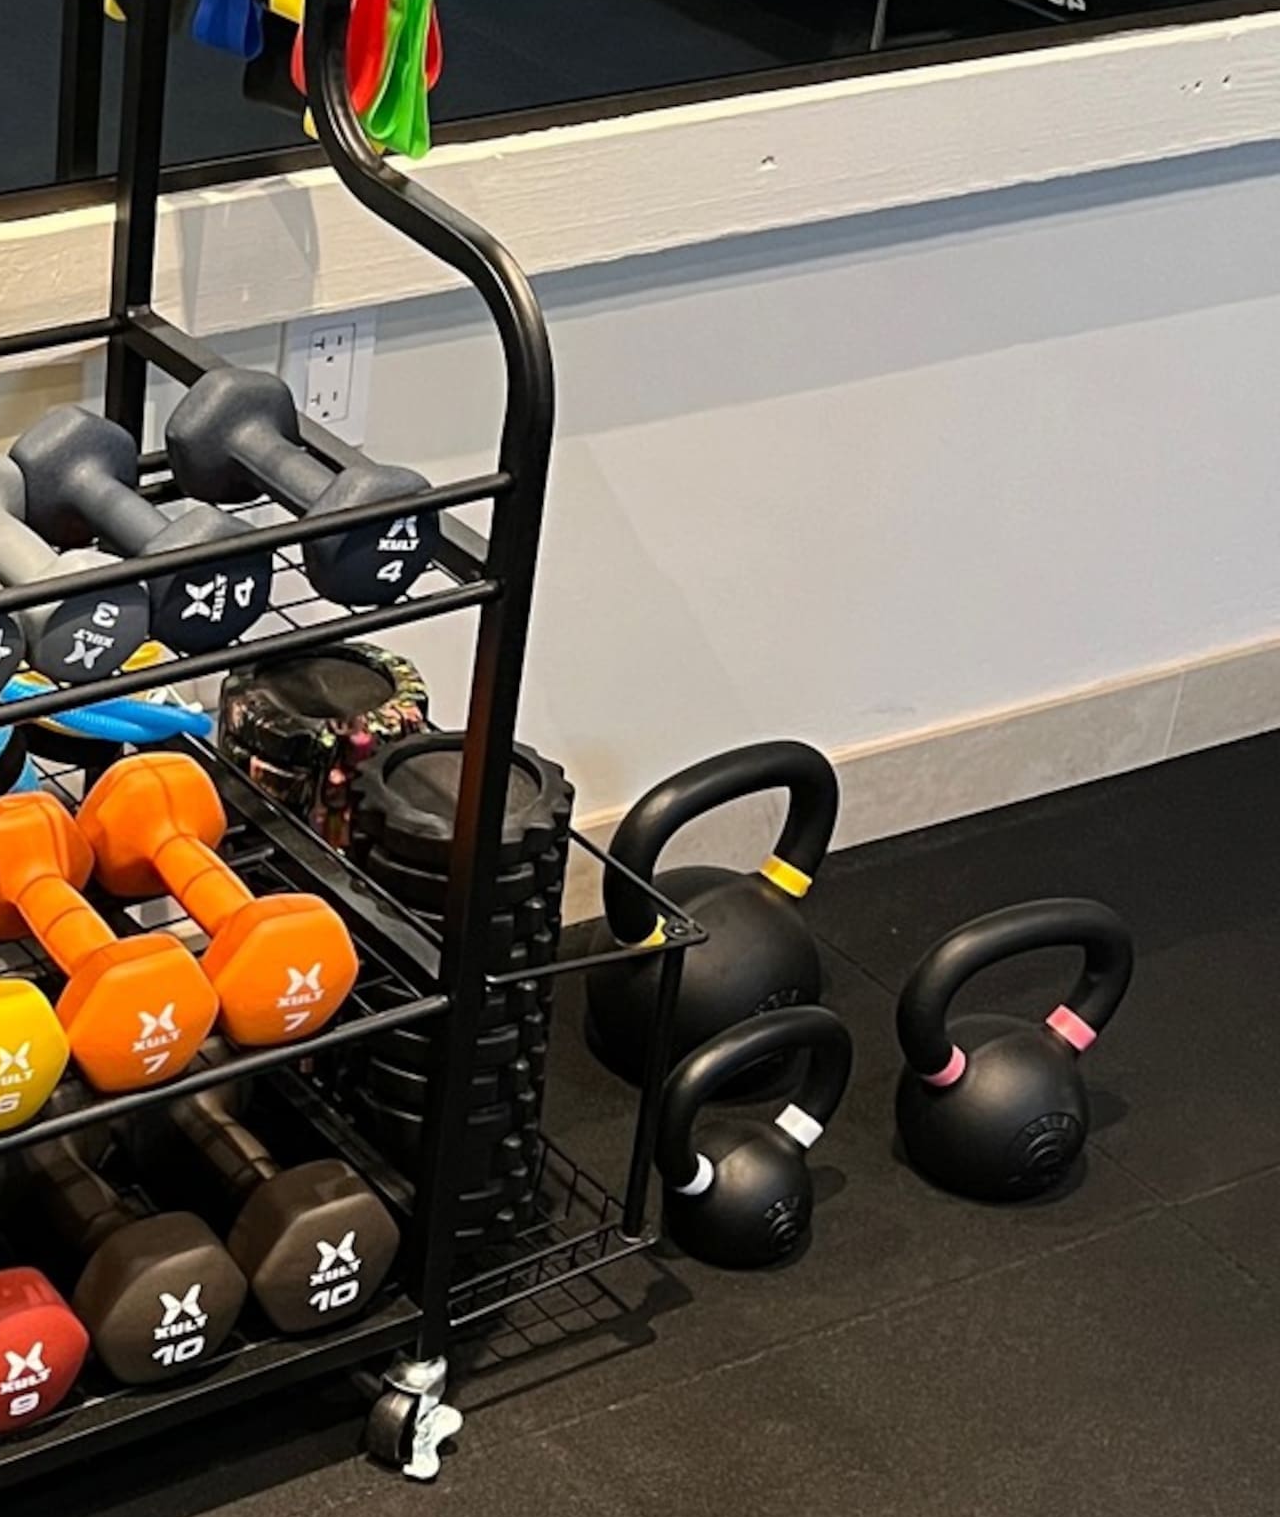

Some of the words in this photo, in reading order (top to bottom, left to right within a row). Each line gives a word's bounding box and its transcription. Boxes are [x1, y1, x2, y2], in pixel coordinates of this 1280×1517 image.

[377, 538, 419, 551] XULT
[377, 559, 404, 582] 4
[233, 576, 255, 608] 4
[92, 603, 119, 628] 3
[276, 988, 325, 1009] XULT
[283, 1011, 312, 1033] 7
[131, 1028, 182, 1054] XULT
[143, 1051, 170, 1076] 7
[309, 1258, 363, 1287] XULT
[309, 1280, 361, 1313] 10
[153, 1312, 209, 1341] XULT
[151, 1335, 206, 1367] 10
[0, 1367, 52, 1395] XULT
[9, 1391, 40, 1417] 9
